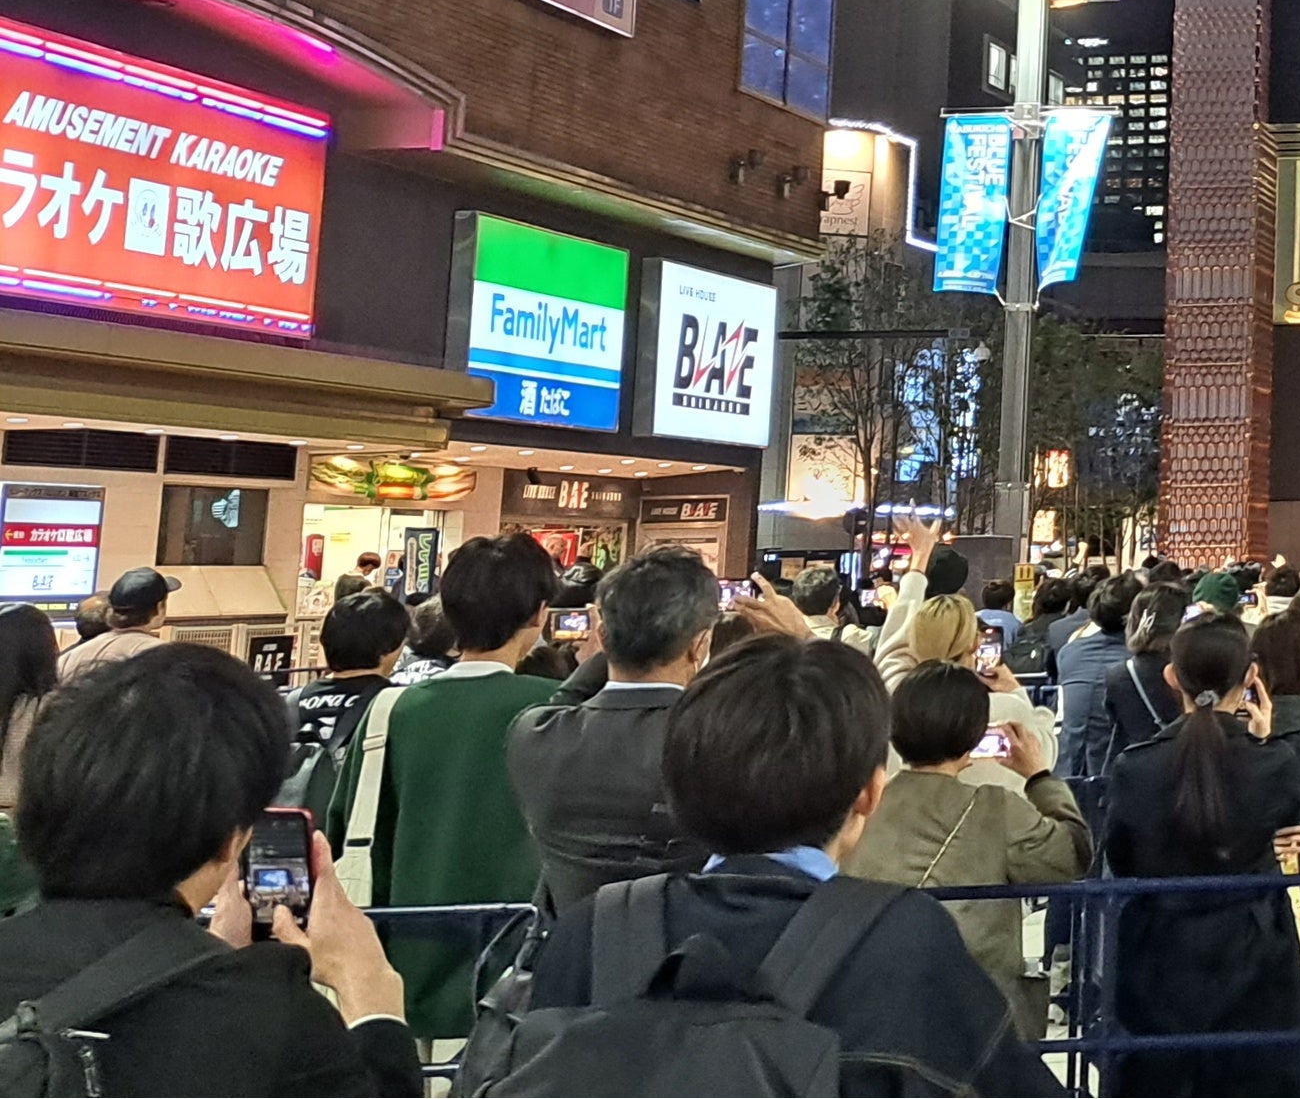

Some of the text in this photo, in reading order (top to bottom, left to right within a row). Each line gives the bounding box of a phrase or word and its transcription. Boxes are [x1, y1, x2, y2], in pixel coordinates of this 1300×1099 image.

[2, 90, 285, 188] AMUSEMENT KARAOKE
[820, 216, 858, 227] apnest
[490, 292, 607, 354] FamilyMart
[518, 379, 571, 416] 酒 たばこ
